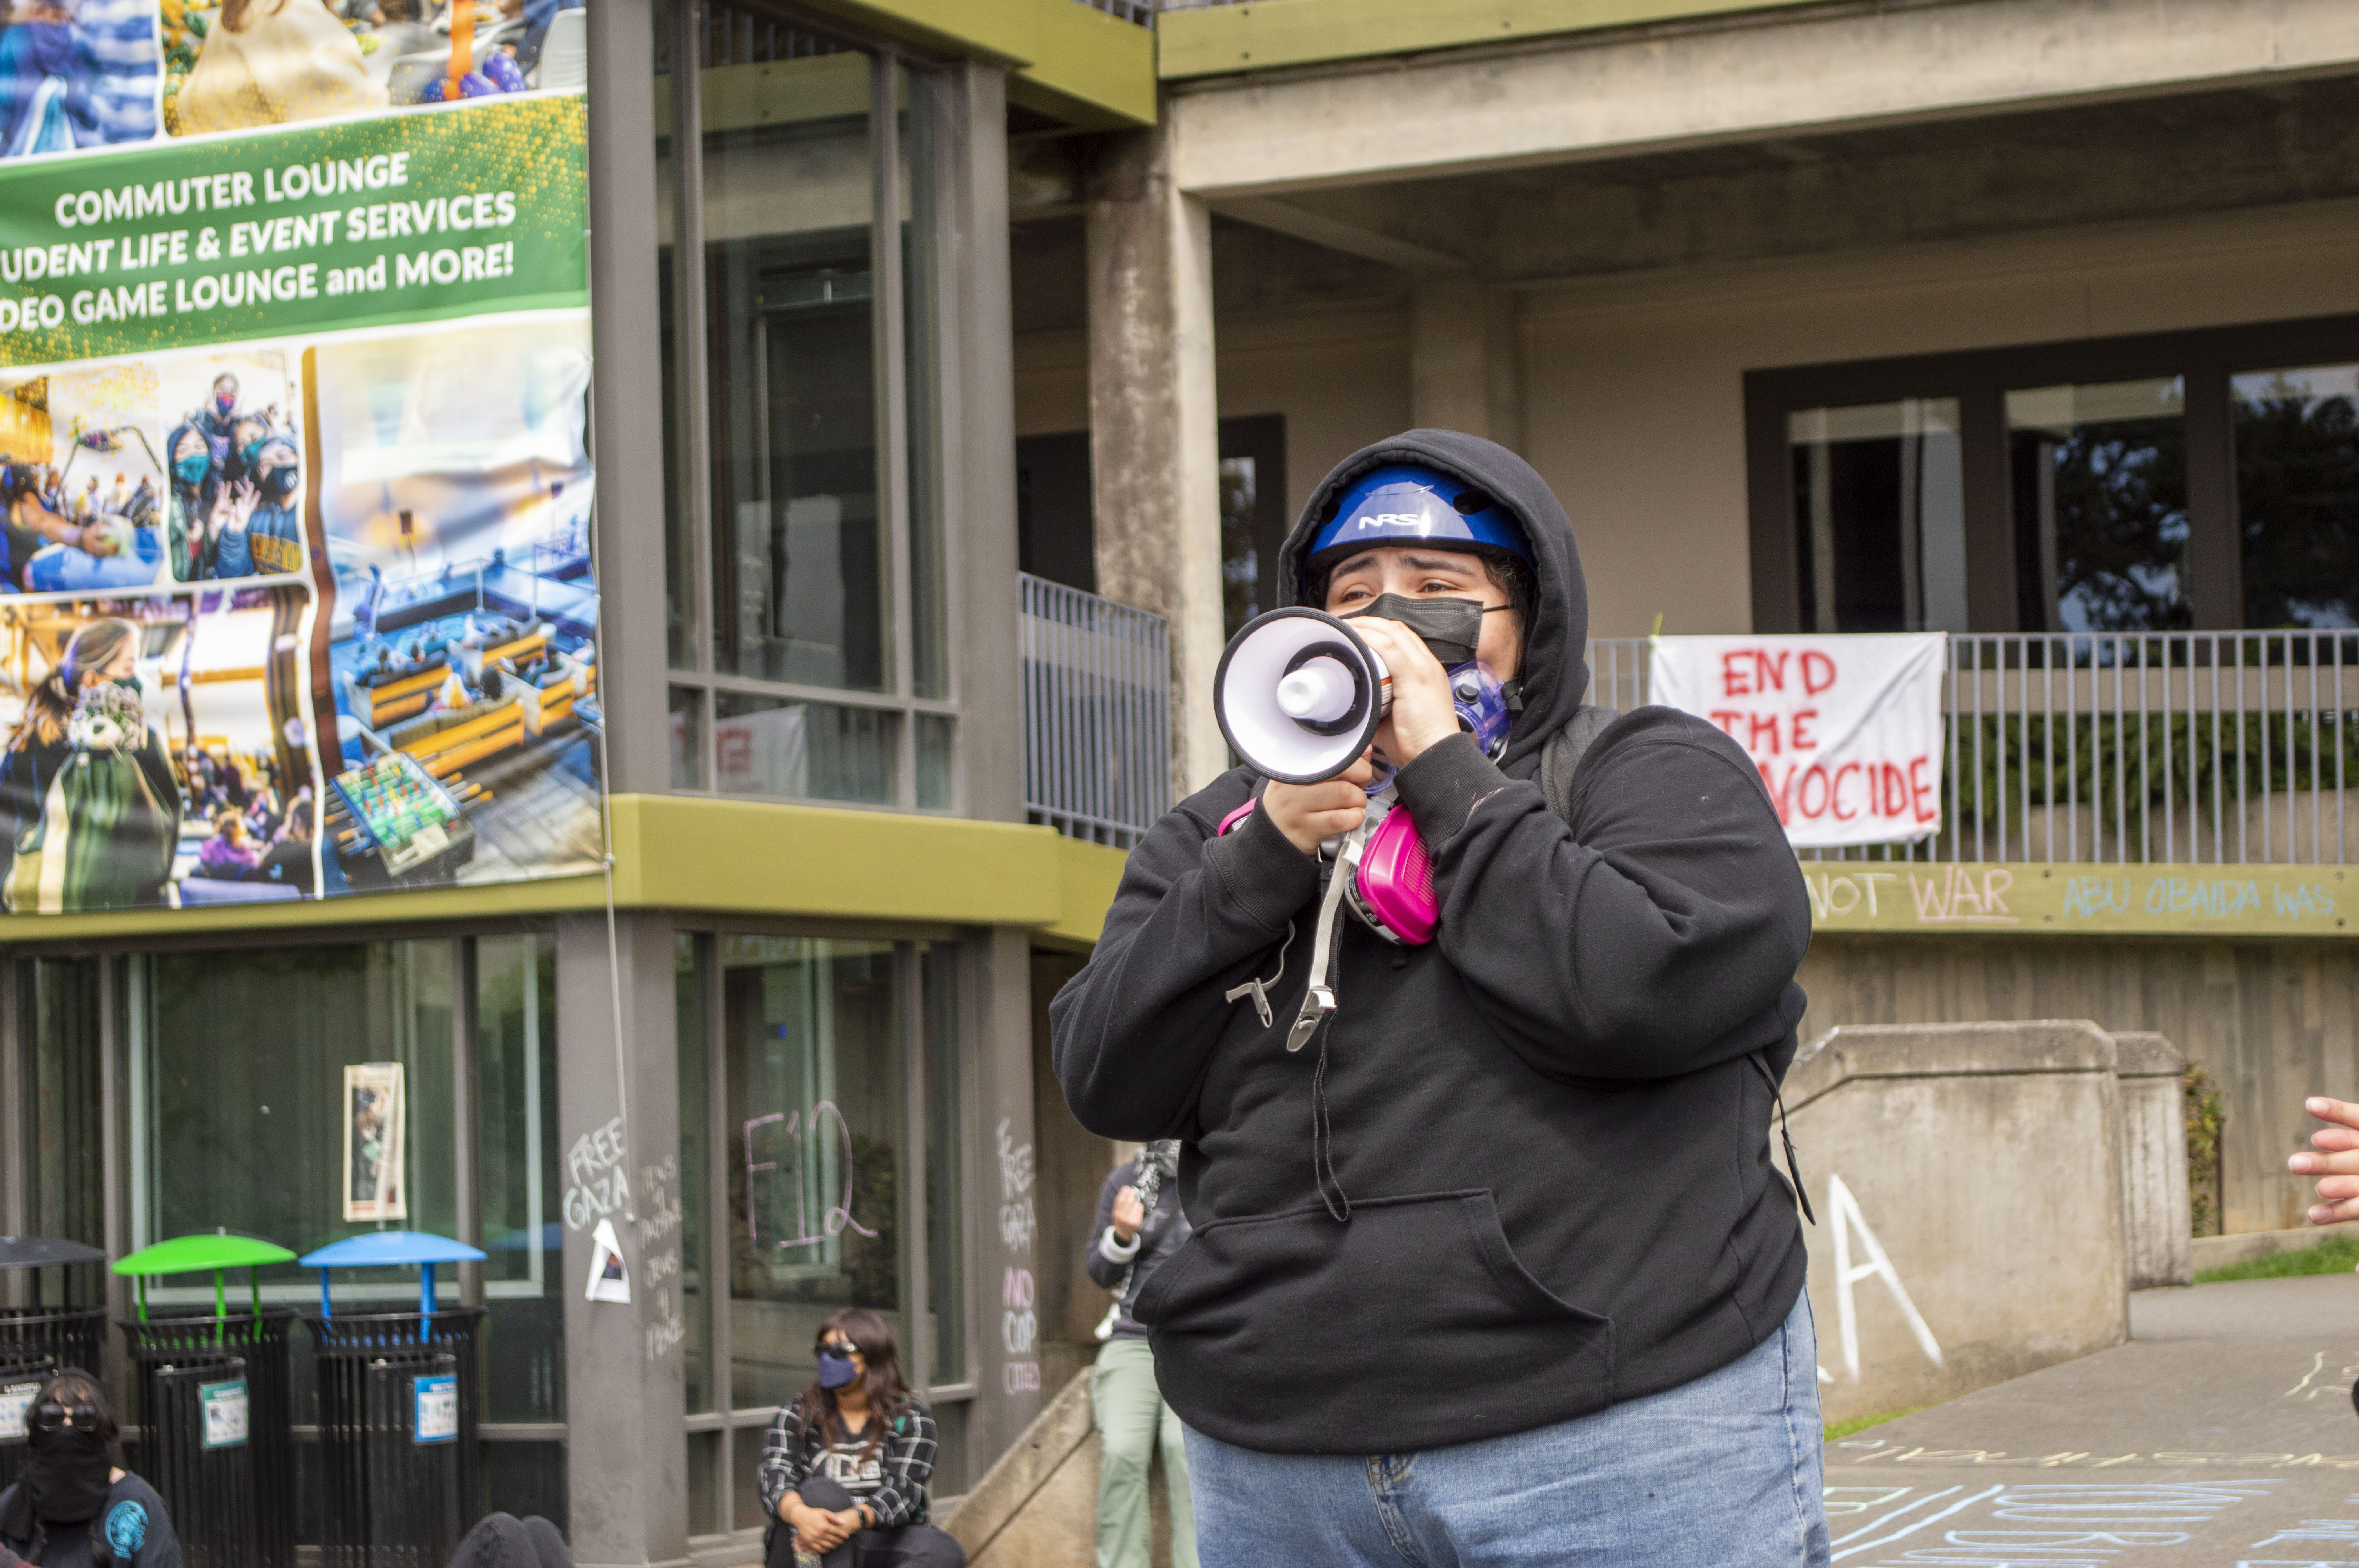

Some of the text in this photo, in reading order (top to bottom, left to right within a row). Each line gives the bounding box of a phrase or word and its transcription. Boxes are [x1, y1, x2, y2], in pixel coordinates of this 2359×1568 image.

[54, 152, 410, 229] COMMUTER LOUNGE
[121, 230, 189, 270] LIFE
[195, 226, 221, 261] &
[229, 210, 342, 257] EVENT
[346, 191, 516, 242] SERVICES
[71, 281, 168, 325] GAME
[175, 263, 318, 312] LOUNGE
[325, 254, 387, 296] and
[396, 241, 514, 289] MORE!
[1359, 513, 1419, 530] NRS
[1723, 646, 1837, 697] END
[1711, 709, 1819, 755] THE
[1805, 873, 1897, 920] NOT
[1908, 864, 2014, 920] WAR
[2064, 876, 2130, 918] ABU
[2145, 877, 2261, 917] OBAIDA
[568, 1117, 626, 1186] FREE
[563, 1164, 630, 1230] GAZA
[1003, 1266, 1034, 1308] NO
[1002, 1310, 1037, 1353] COP
